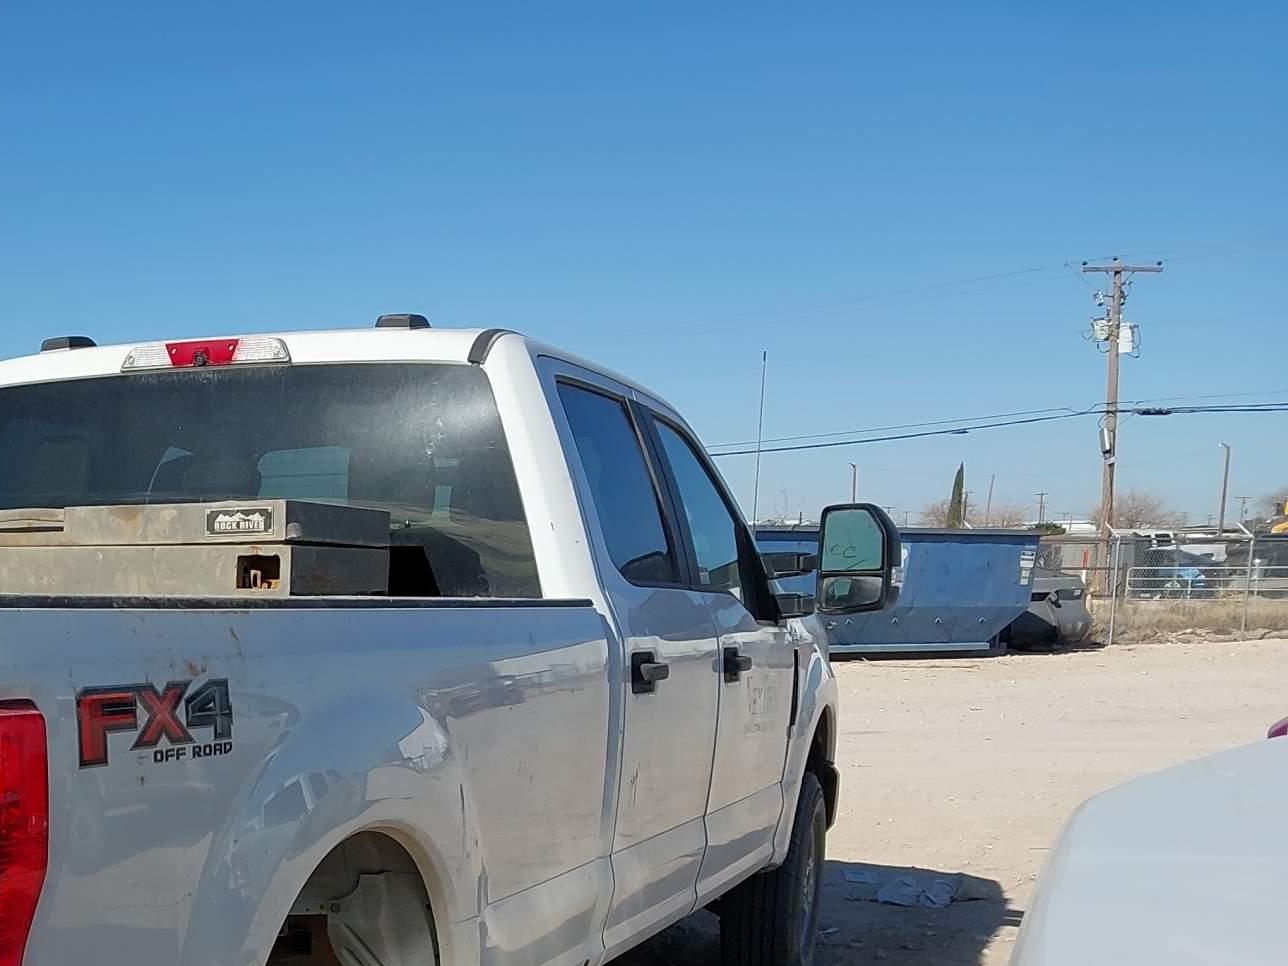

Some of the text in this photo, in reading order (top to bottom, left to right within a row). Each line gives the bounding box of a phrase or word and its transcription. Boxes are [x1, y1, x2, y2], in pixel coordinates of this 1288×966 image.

[214, 521, 238, 531] ROCK
[75, 678, 234, 770] FX4
[153, 741, 233, 763] OFF ROAD
